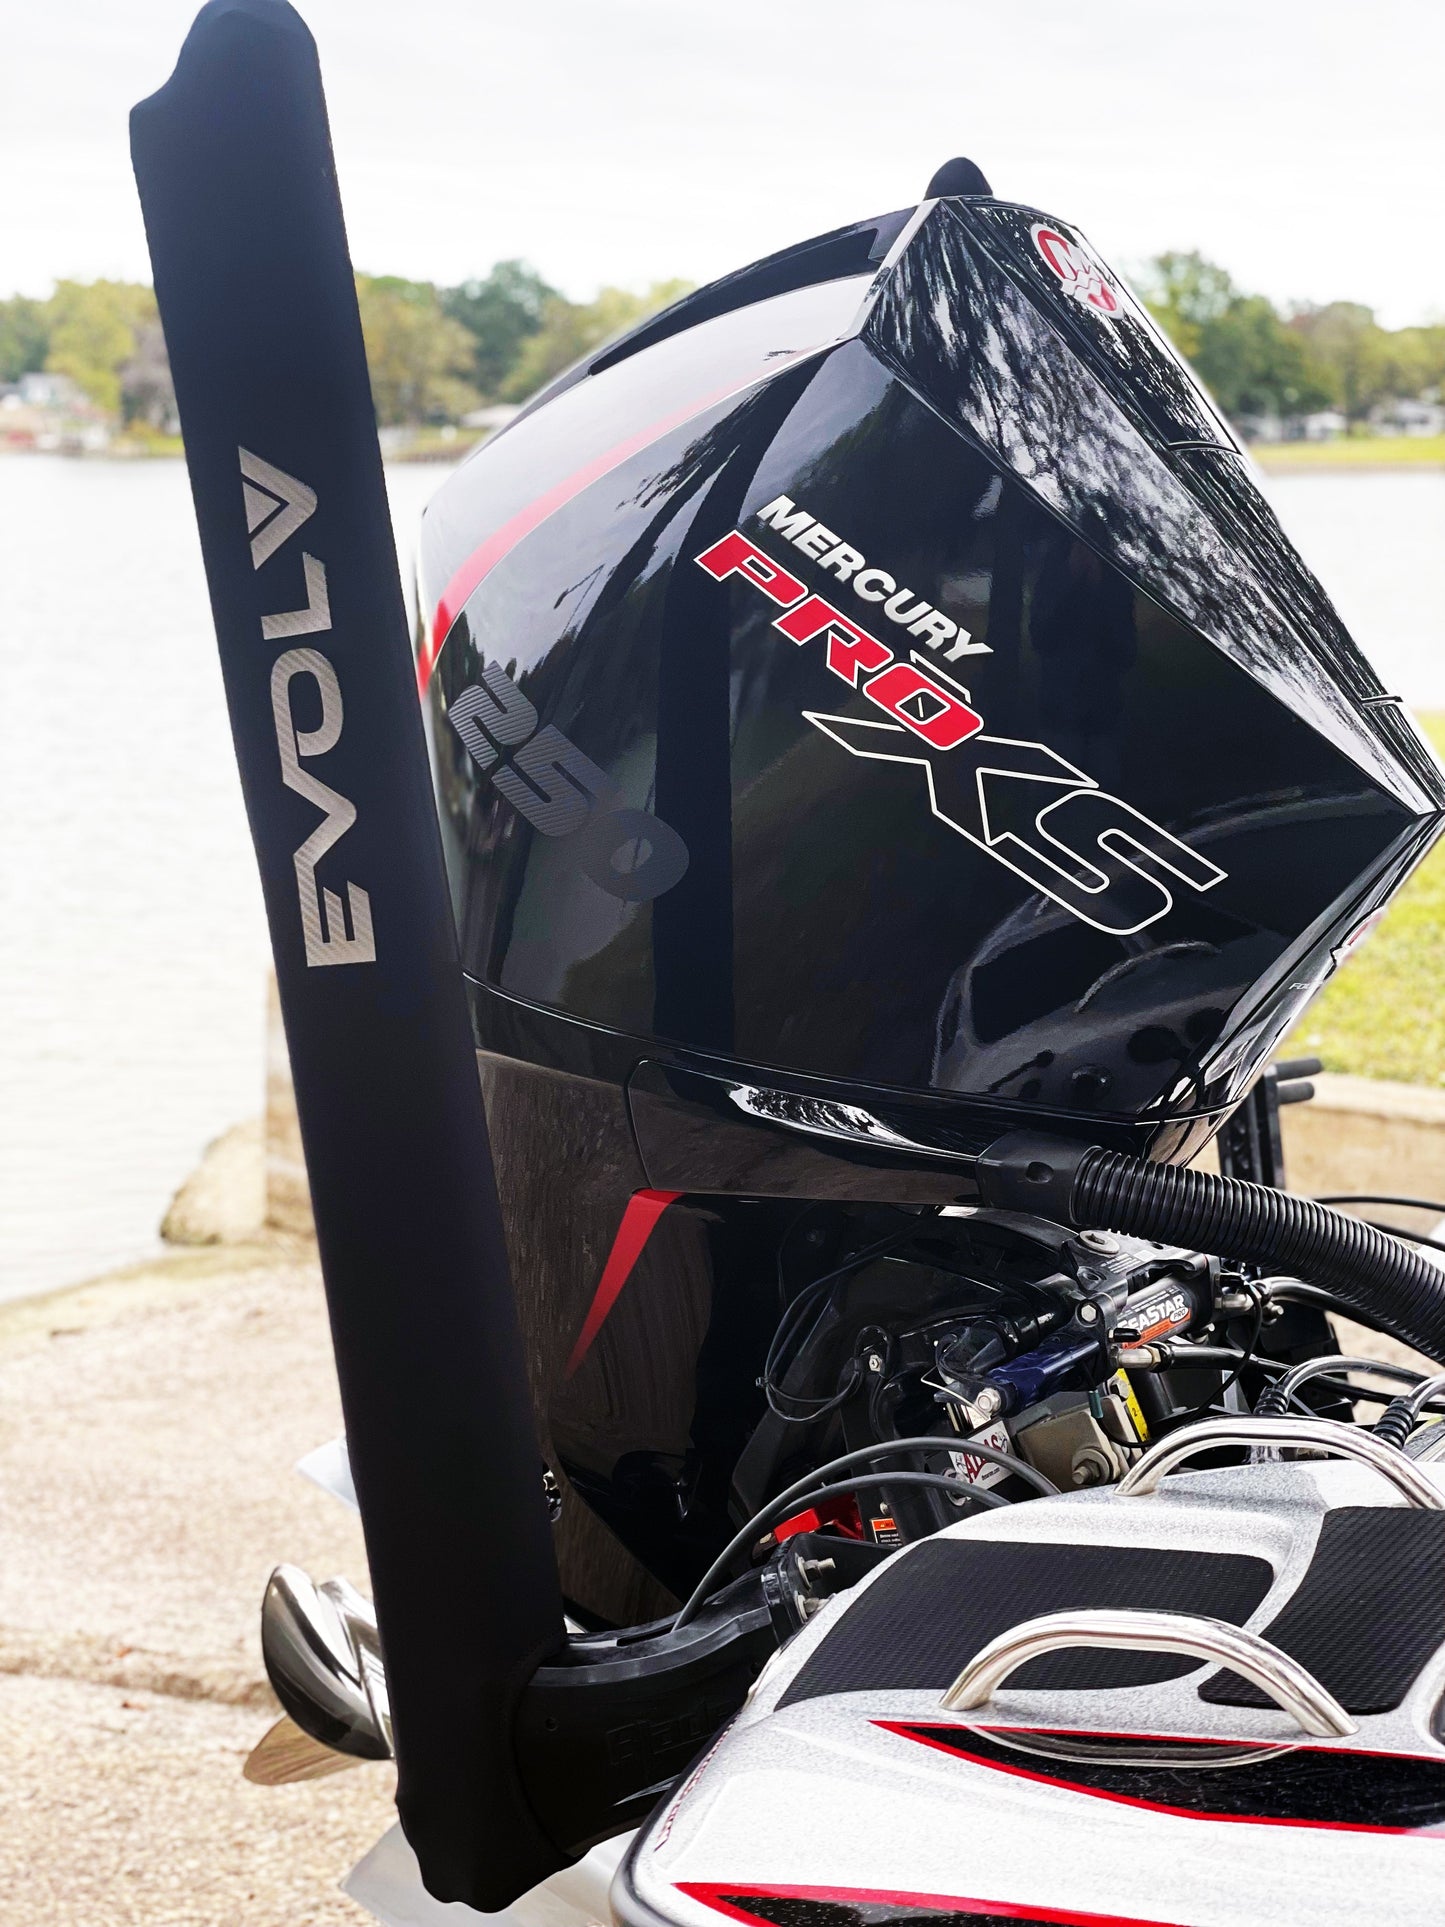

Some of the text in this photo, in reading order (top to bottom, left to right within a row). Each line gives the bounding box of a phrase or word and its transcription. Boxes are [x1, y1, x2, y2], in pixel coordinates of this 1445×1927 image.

[694, 530, 984, 750] PRO
[756, 495, 994, 663] MERCURY
[238, 445, 376, 967] EVOLV
[448, 660, 690, 900] 250
[801, 649, 1228, 936] XS
